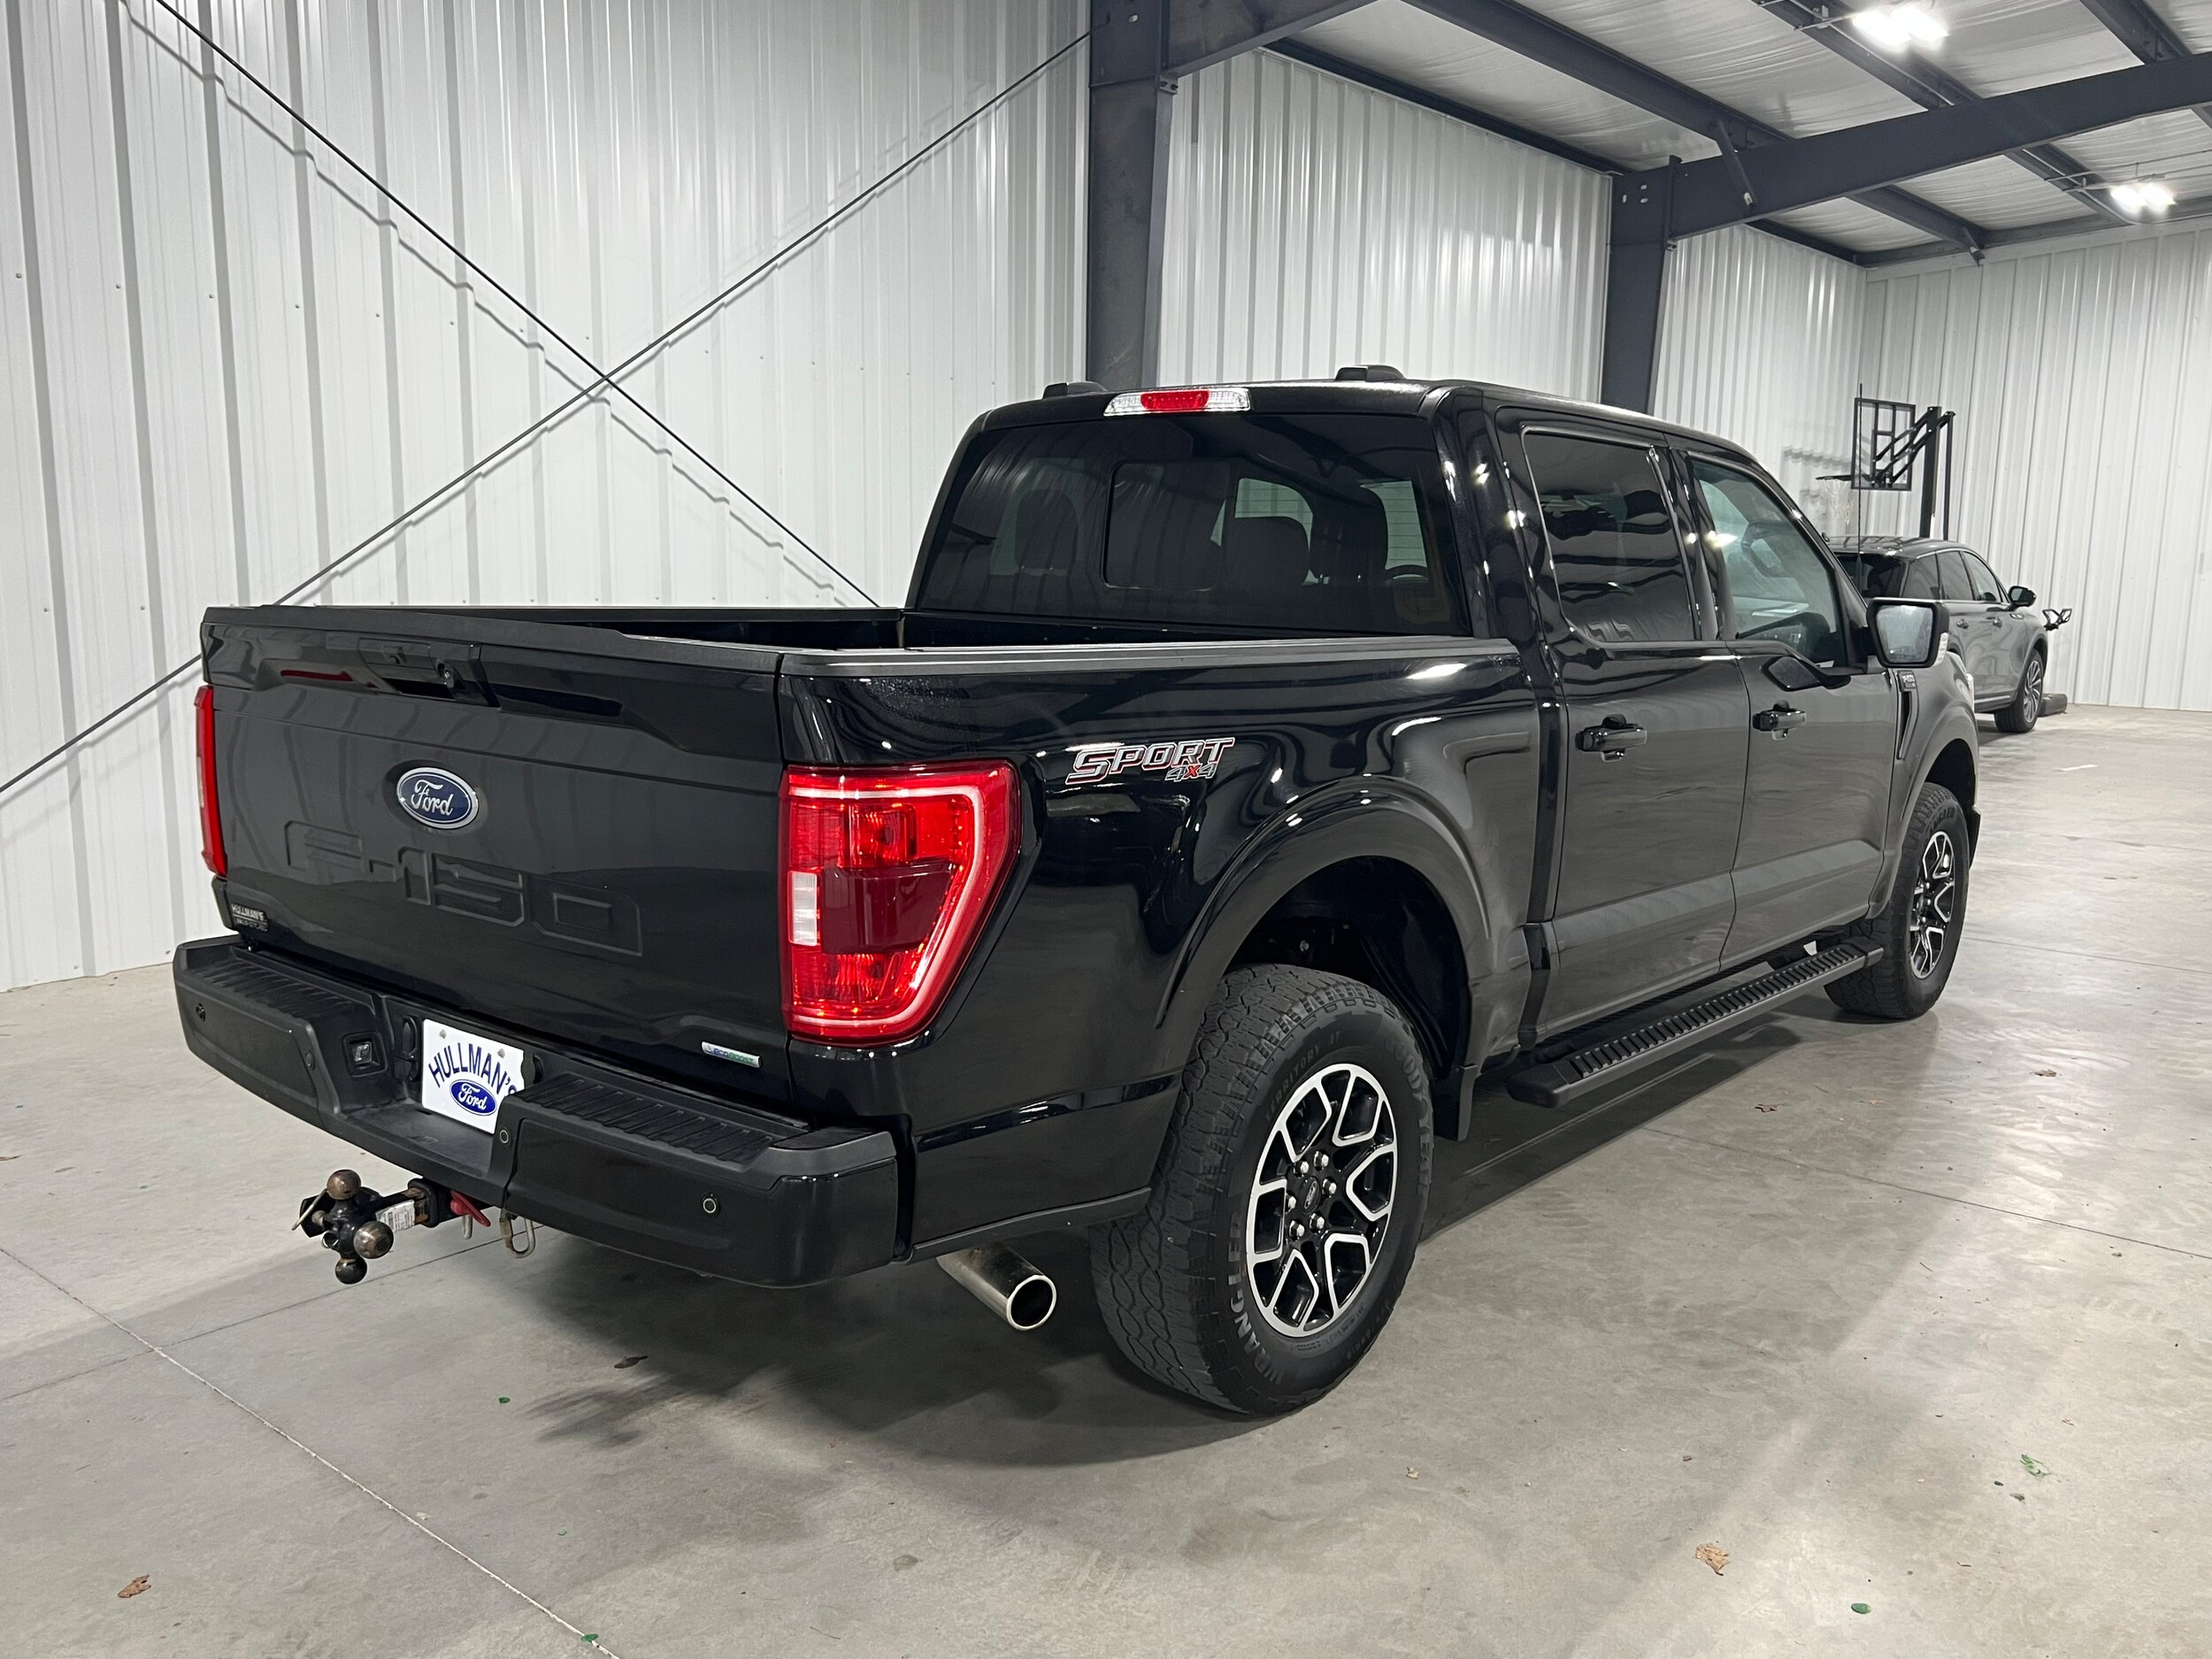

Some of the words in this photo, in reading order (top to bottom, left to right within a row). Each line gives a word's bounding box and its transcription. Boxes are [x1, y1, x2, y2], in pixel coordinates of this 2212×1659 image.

[1065, 737, 1235, 785] SPORT
[411, 780, 454, 816] Ford
[284, 820, 642, 956] F-150
[458, 1083, 488, 1110] Ford
[1227, 1210, 1285, 1386] WRANGLER
